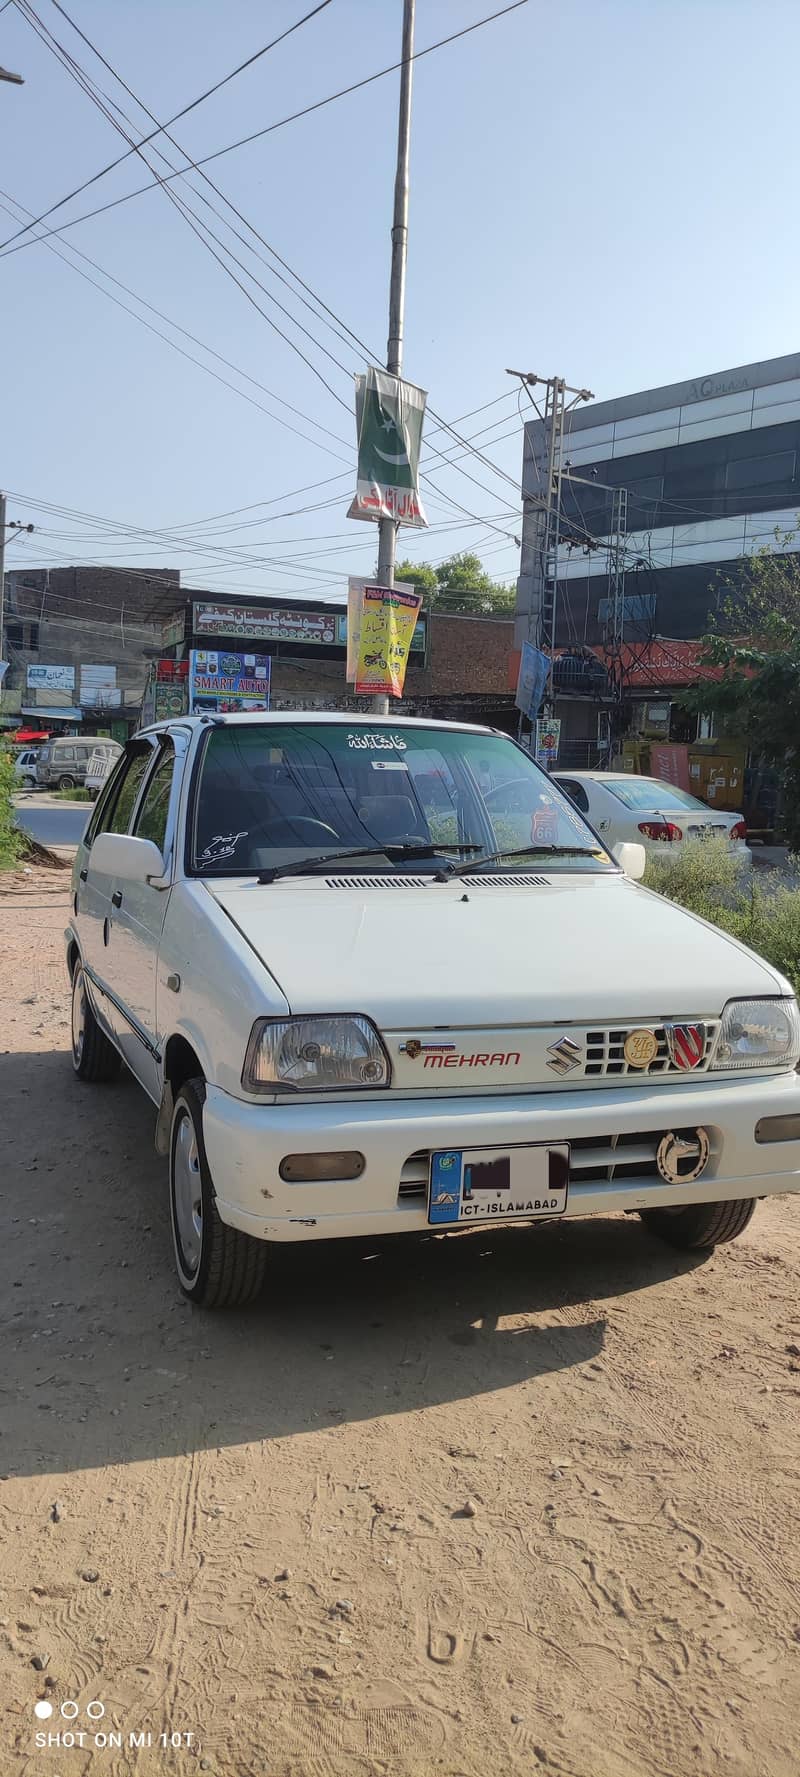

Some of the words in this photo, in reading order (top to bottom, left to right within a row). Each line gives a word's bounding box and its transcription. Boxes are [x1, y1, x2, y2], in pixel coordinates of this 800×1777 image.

[193, 676, 234, 690] SMART
[238, 679, 269, 693] AUTO
[536, 826, 553, 839] 66
[423, 1052, 521, 1068] MEHRAN
[460, 1198, 558, 1216] ICT-ISLAMABAD
